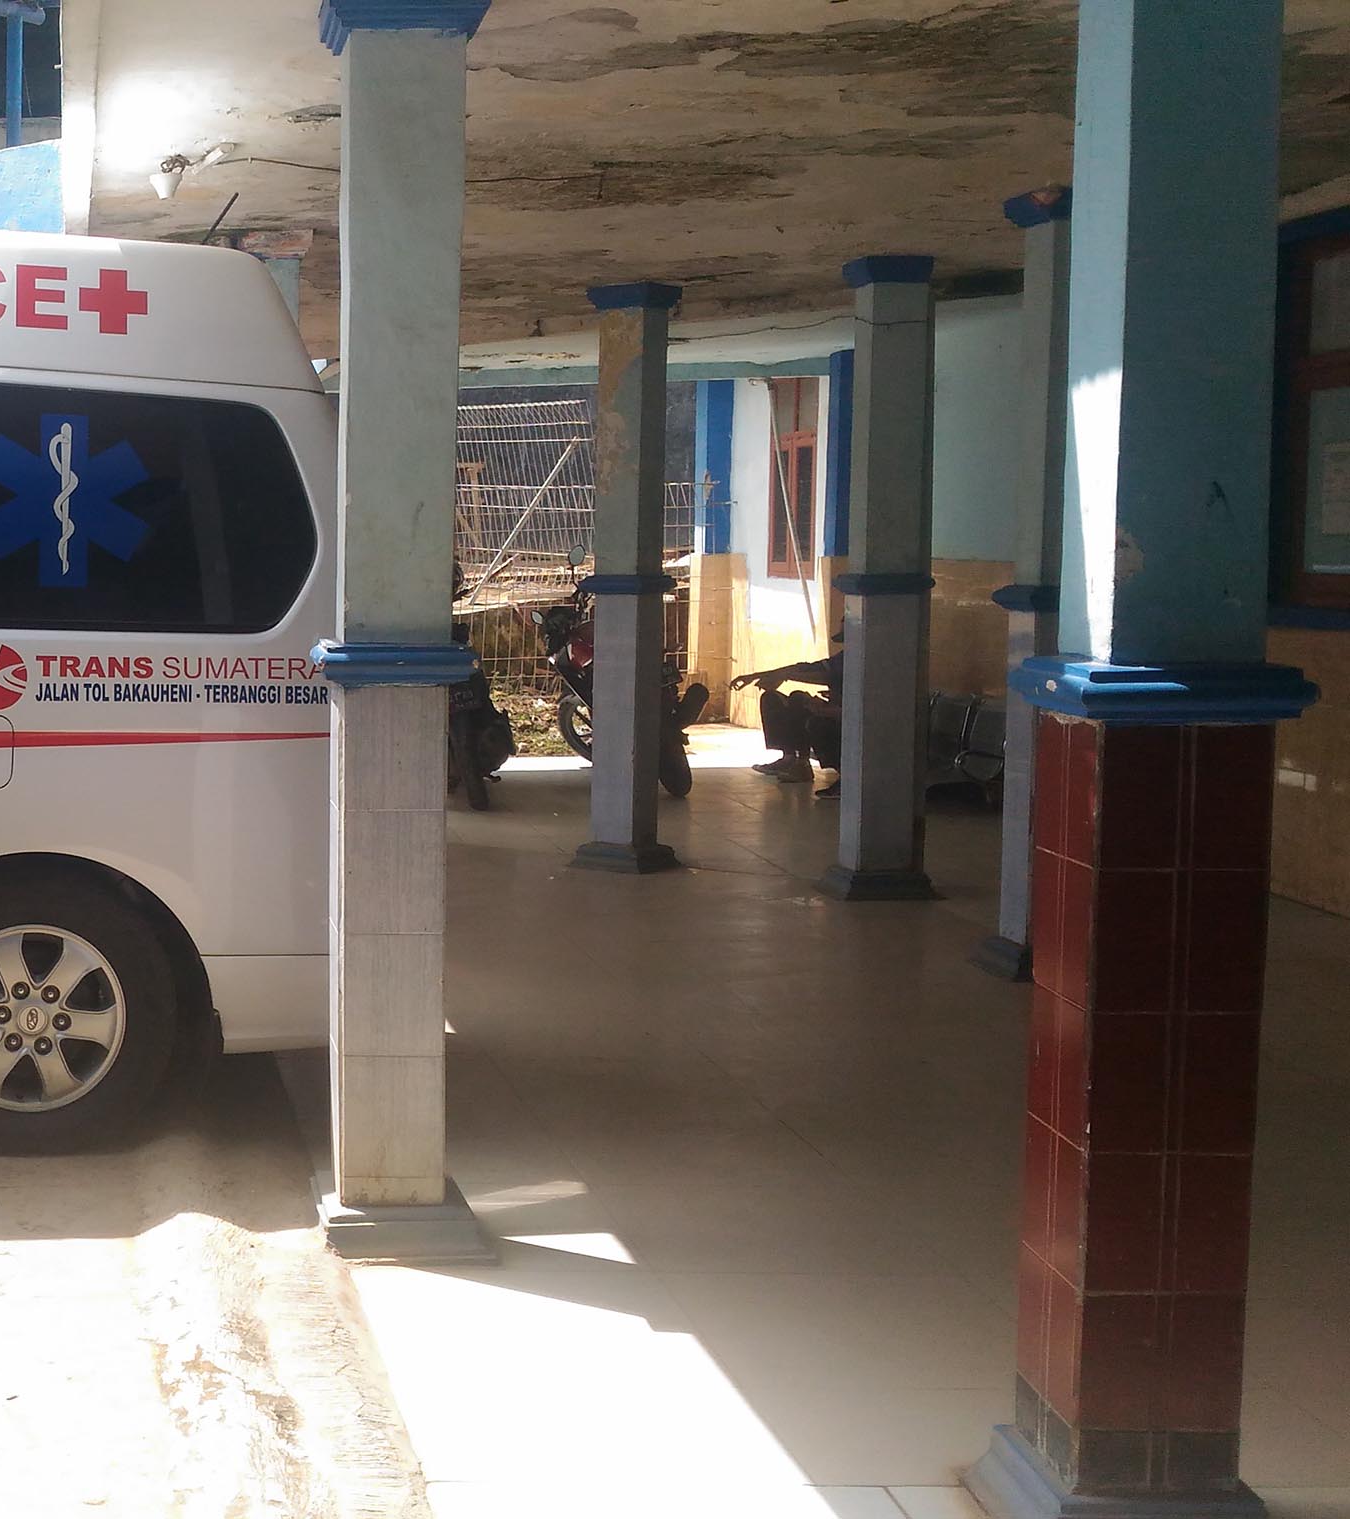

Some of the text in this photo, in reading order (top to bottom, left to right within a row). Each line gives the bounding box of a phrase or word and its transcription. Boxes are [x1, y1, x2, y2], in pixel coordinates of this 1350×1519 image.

[36, 655, 154, 679] TRANS
[35, 683, 79, 702] JALAN
[83, 683, 110, 702] TOL
[114, 683, 193, 703] BAKAUHENI
[204, 685, 281, 704] TERBANGGI
[285, 686, 328, 705] BESAR
